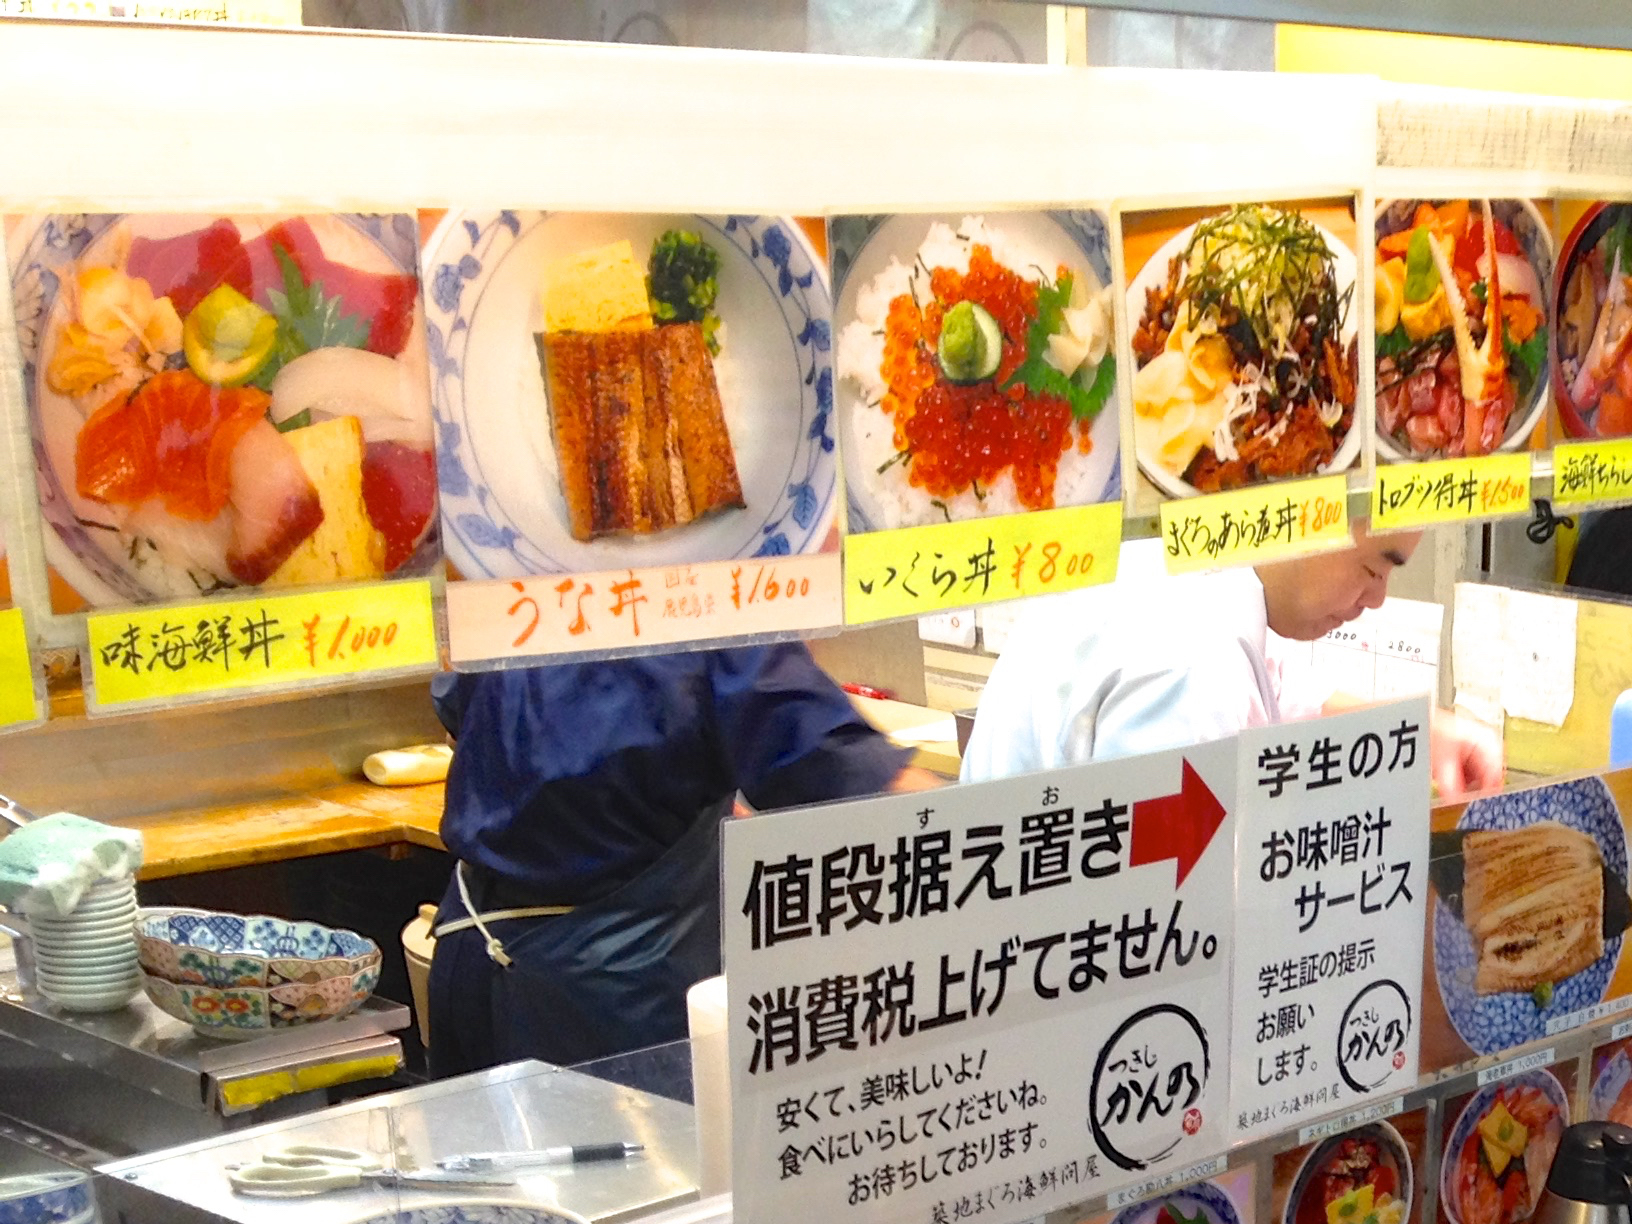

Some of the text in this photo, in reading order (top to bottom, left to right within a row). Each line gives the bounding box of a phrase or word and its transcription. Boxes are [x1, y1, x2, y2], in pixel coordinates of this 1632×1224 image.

[1166, 495, 1342, 561] まぐろのあら煮丼 ¥800
[859, 537, 1093, 598] いくら丼 ¥800
[99, 608, 285, 675] 味海鮮丼
[507, 569, 648, 648] うな丼
[1258, 719, 1419, 799] 学生の方
[916, 806, 935, 830] す
[1041, 785, 1060, 807] お
[742, 797, 1130, 951] 値段据え置き
[1259, 806, 1392, 883] お味噌汁
[1294, 860, 1414, 934] サービス
[747, 899, 1219, 1076] 消費税上げてません。
[1258, 938, 1376, 999] 学生証の提示
[1256, 1003, 1315, 1044] お願い
[1108, 1044, 1158, 1076] つきじ
[1257, 1043, 1318, 1087] します。
[778, 1079, 1048, 1181] 食べにいらしてくださいね。
[1235, 1082, 1341, 1131] 築地まぐろ海鮮問屋
[847, 1122, 1048, 1206] お待ちしております。
